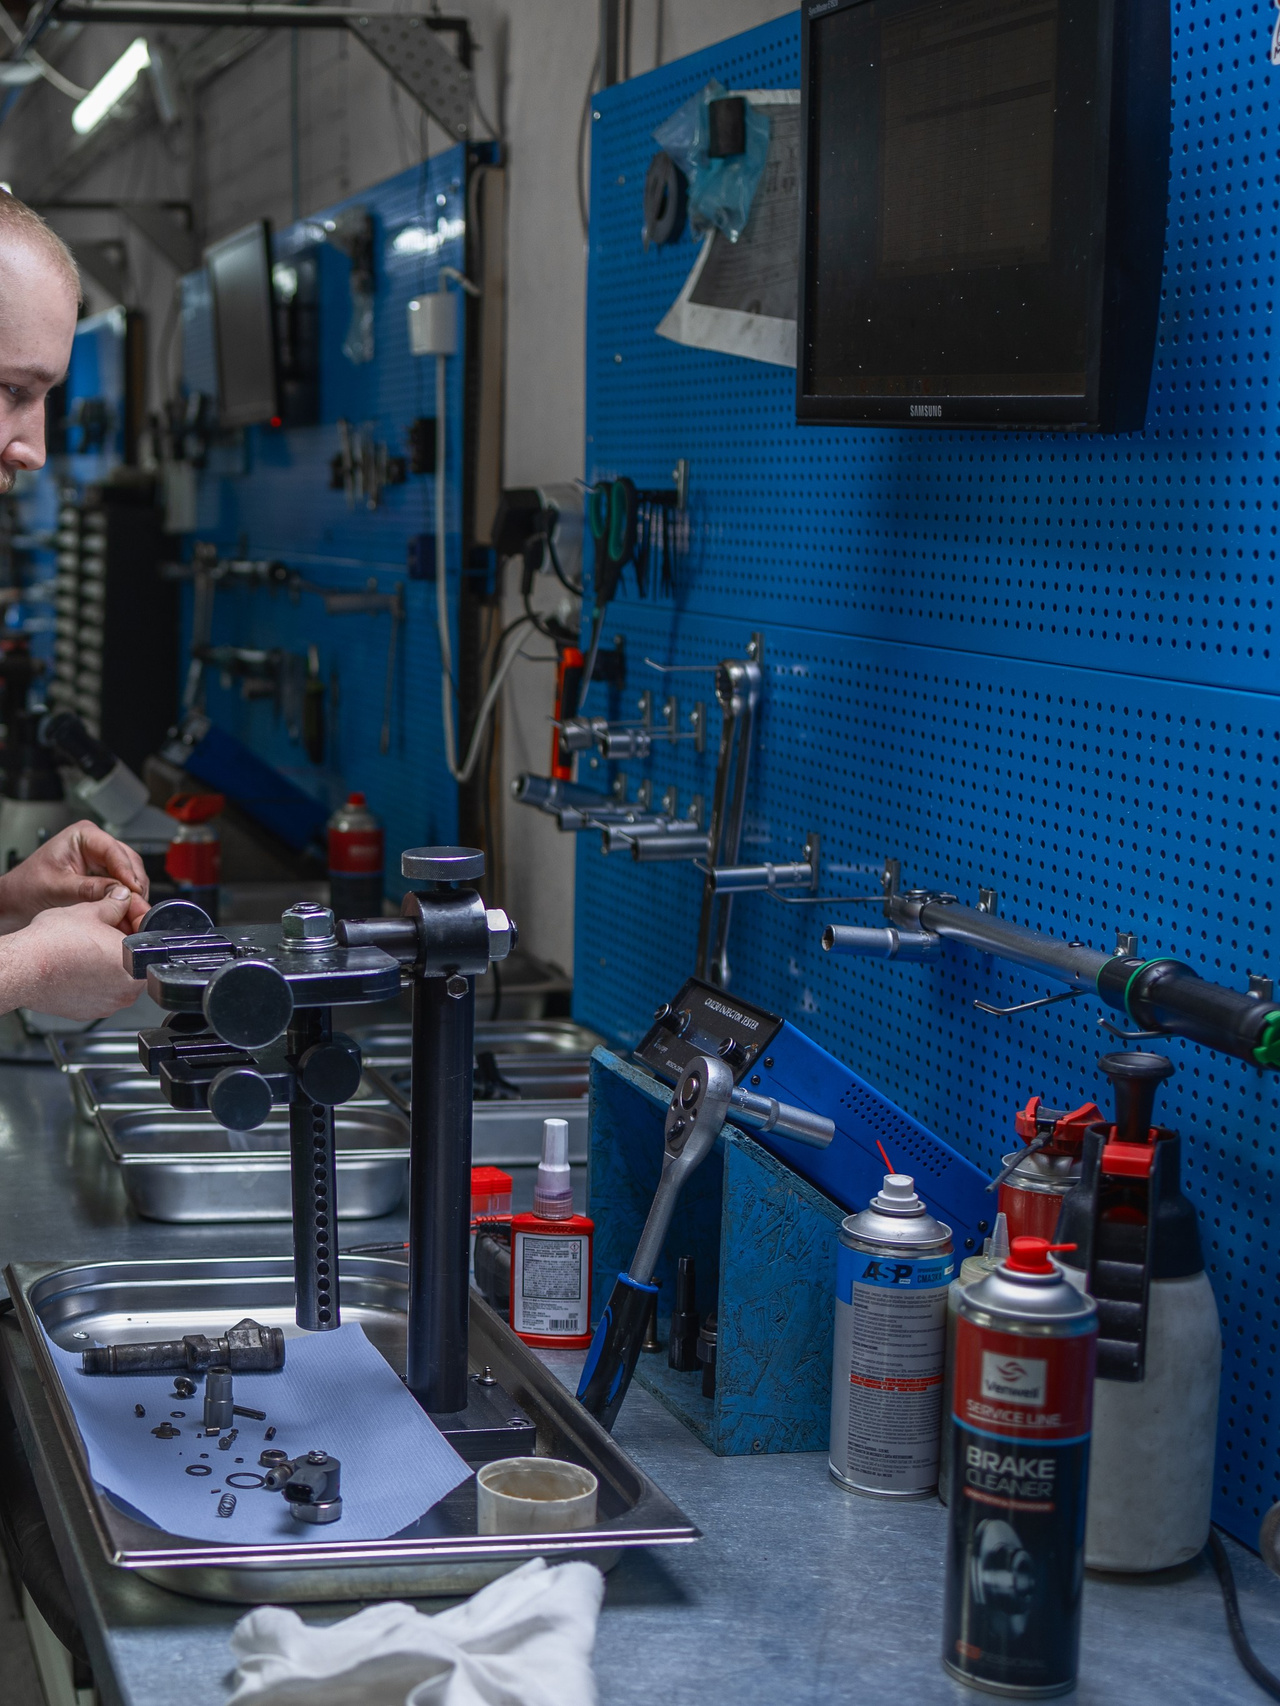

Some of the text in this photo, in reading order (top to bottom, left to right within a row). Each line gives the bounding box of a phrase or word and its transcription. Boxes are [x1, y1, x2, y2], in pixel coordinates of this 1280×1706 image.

[909, 404, 942, 417] SAMSUNG
[720, 1003, 743, 1022] INJECTOR
[740, 1014, 760, 1031] TESTER
[862, 1261, 913, 1284] ASP
[985, 1379, 1040, 1399] Venwell
[966, 1399, 1062, 1426] SERVICE LINE
[966, 1444, 1056, 1479] BRAKE
[965, 1467, 1054, 1498] CLEANER
